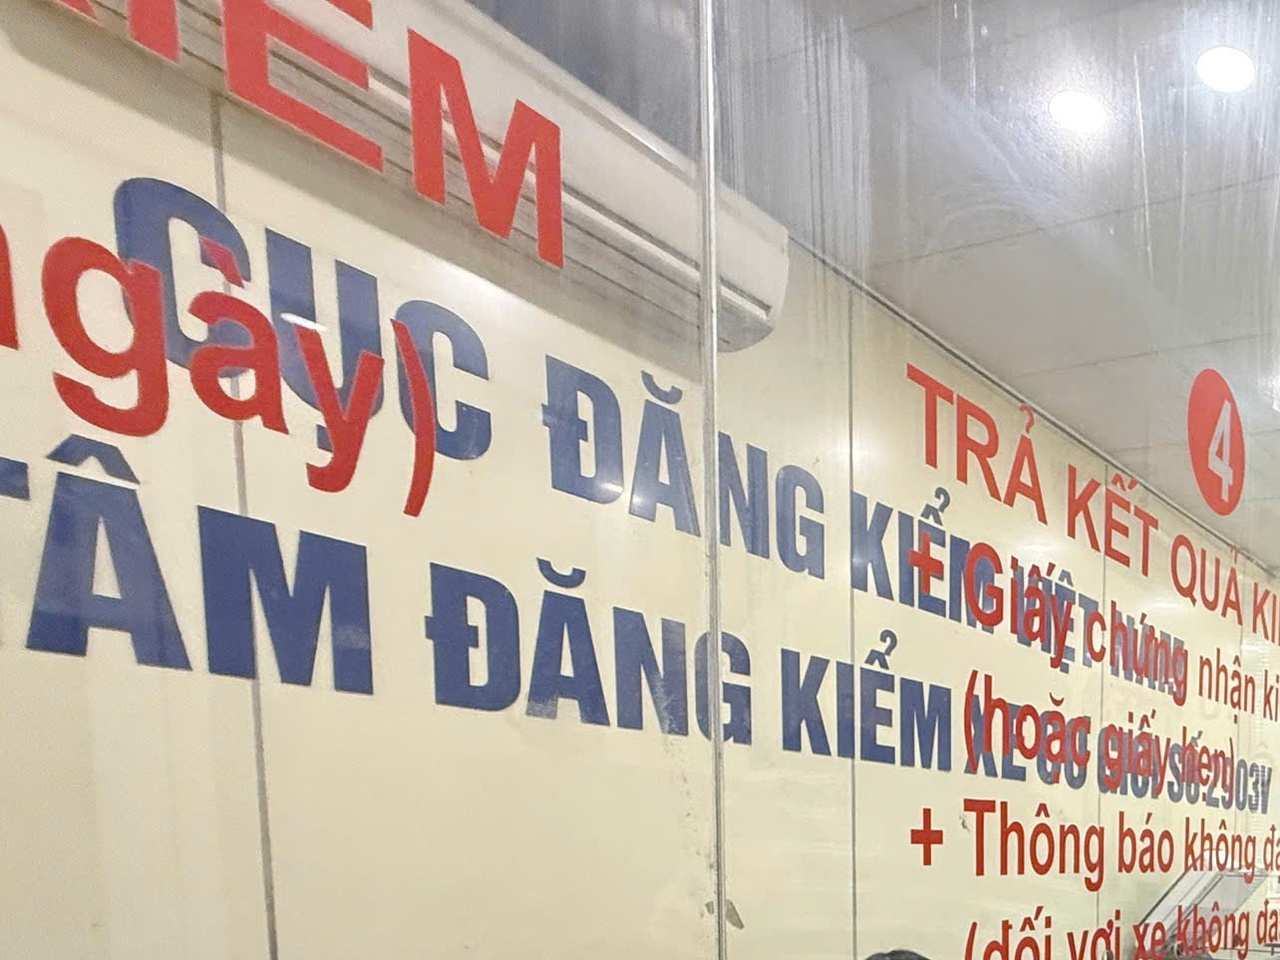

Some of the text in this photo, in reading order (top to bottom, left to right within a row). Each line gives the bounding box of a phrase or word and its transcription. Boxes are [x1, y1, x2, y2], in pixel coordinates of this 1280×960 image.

[541, 354, 826, 579] ĐĂNG
[850, 486, 994, 634] KIỂM
[906, 363, 1048, 525] TRẢ
[1067, 464, 1159, 578] KẾT
[1171, 534, 1243, 626] QUẢ
[1208, 402, 1234, 502] 4
[0, 434, 374, 694] ÂM
[425, 558, 752, 745] ĐĂNG
[781, 629, 952, 773] KIỂM
[965, 542, 1073, 669] Giấy
[1086, 600, 1188, 707] chứng
[1199, 648, 1256, 724] nhận
[964, 669, 1091, 784] (hoặc
[1104, 709, 1171, 796] giấy
[964, 798, 1104, 892] Thông
[1117, 811, 1174, 874] báo
[1184, 817, 1256, 884] không
[1177, 901, 1249, 960] không
